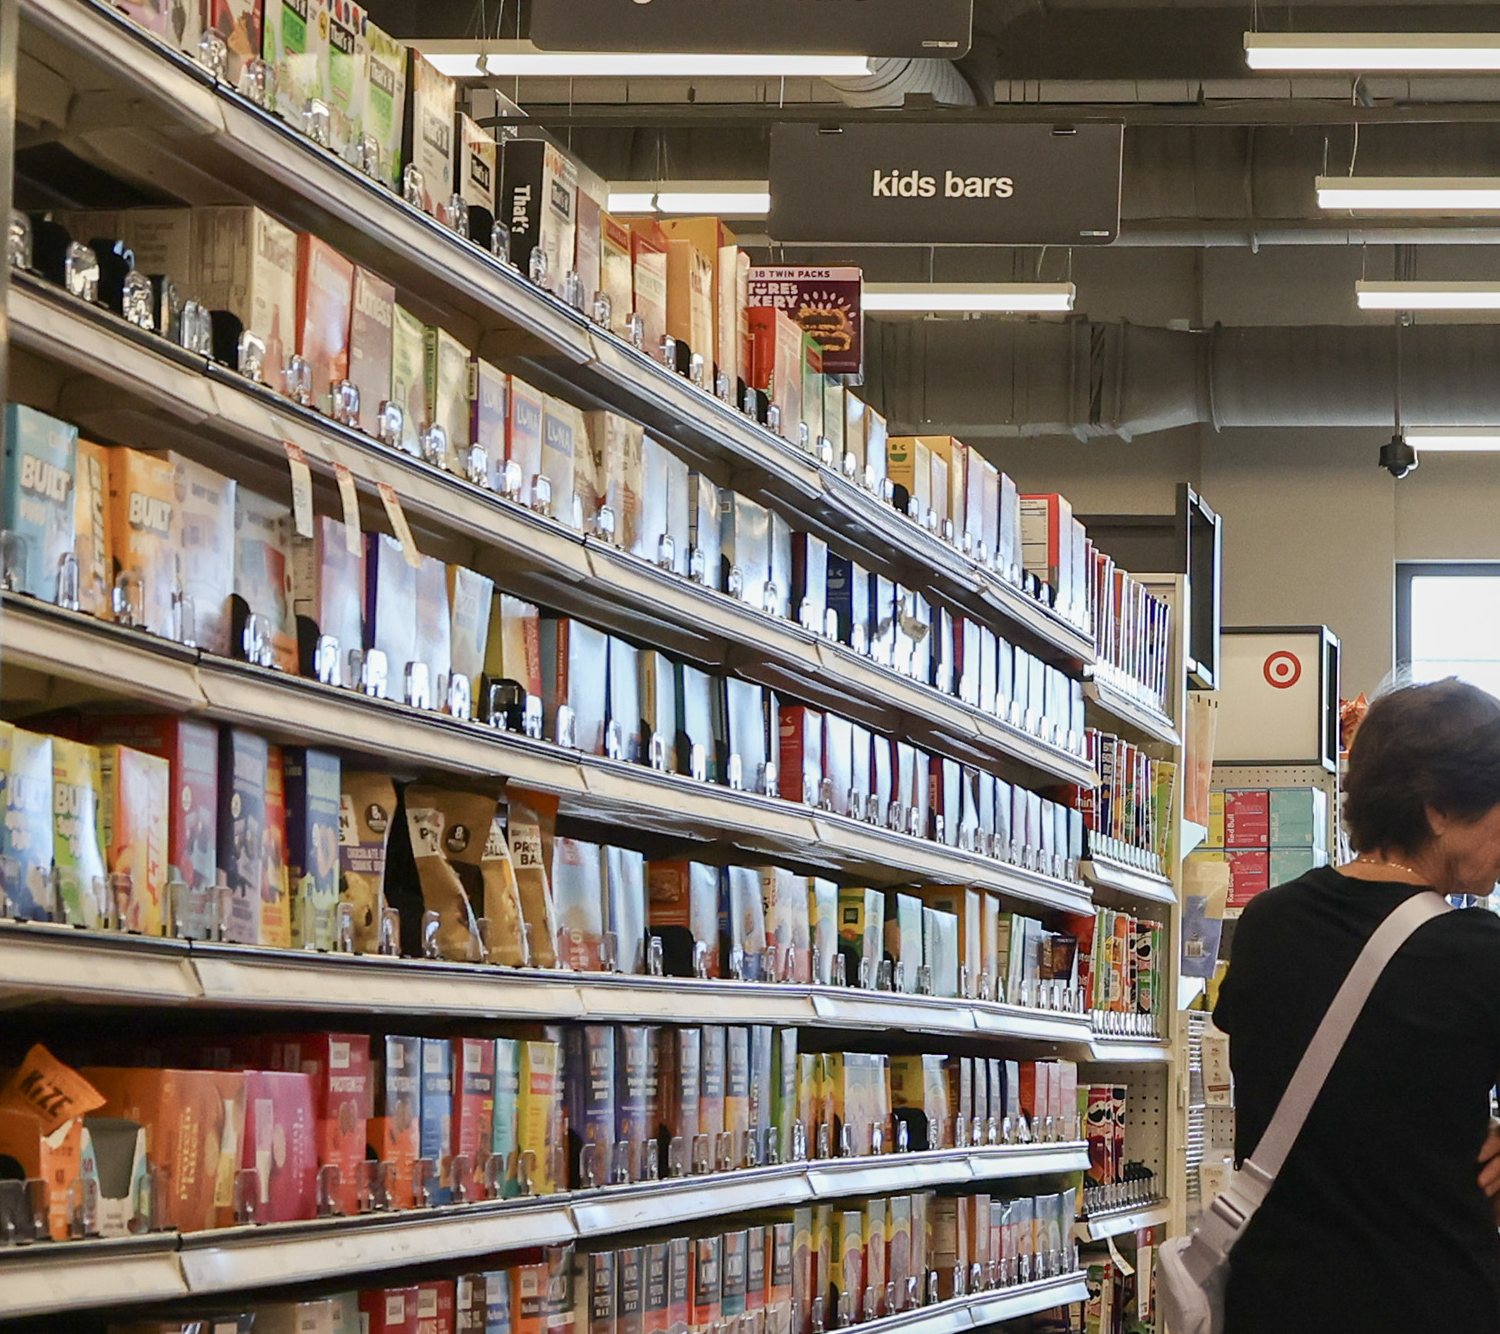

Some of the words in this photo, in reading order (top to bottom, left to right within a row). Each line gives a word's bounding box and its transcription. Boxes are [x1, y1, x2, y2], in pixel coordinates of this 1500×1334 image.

[872, 170, 935, 198] kids
[945, 170, 1014, 198] bars
[512, 185, 531, 235] That's
[754, 270, 765, 278] 18
[769, 270, 795, 278] TWIN
[797, 270, 830, 278] PACKS
[547, 421, 571, 452] LUNA
[21, 453, 72, 503] BUILT
[129, 493, 173, 533] BUILT
[1228, 814, 1236, 827] Bull
[1228, 828, 1236, 843] Red
